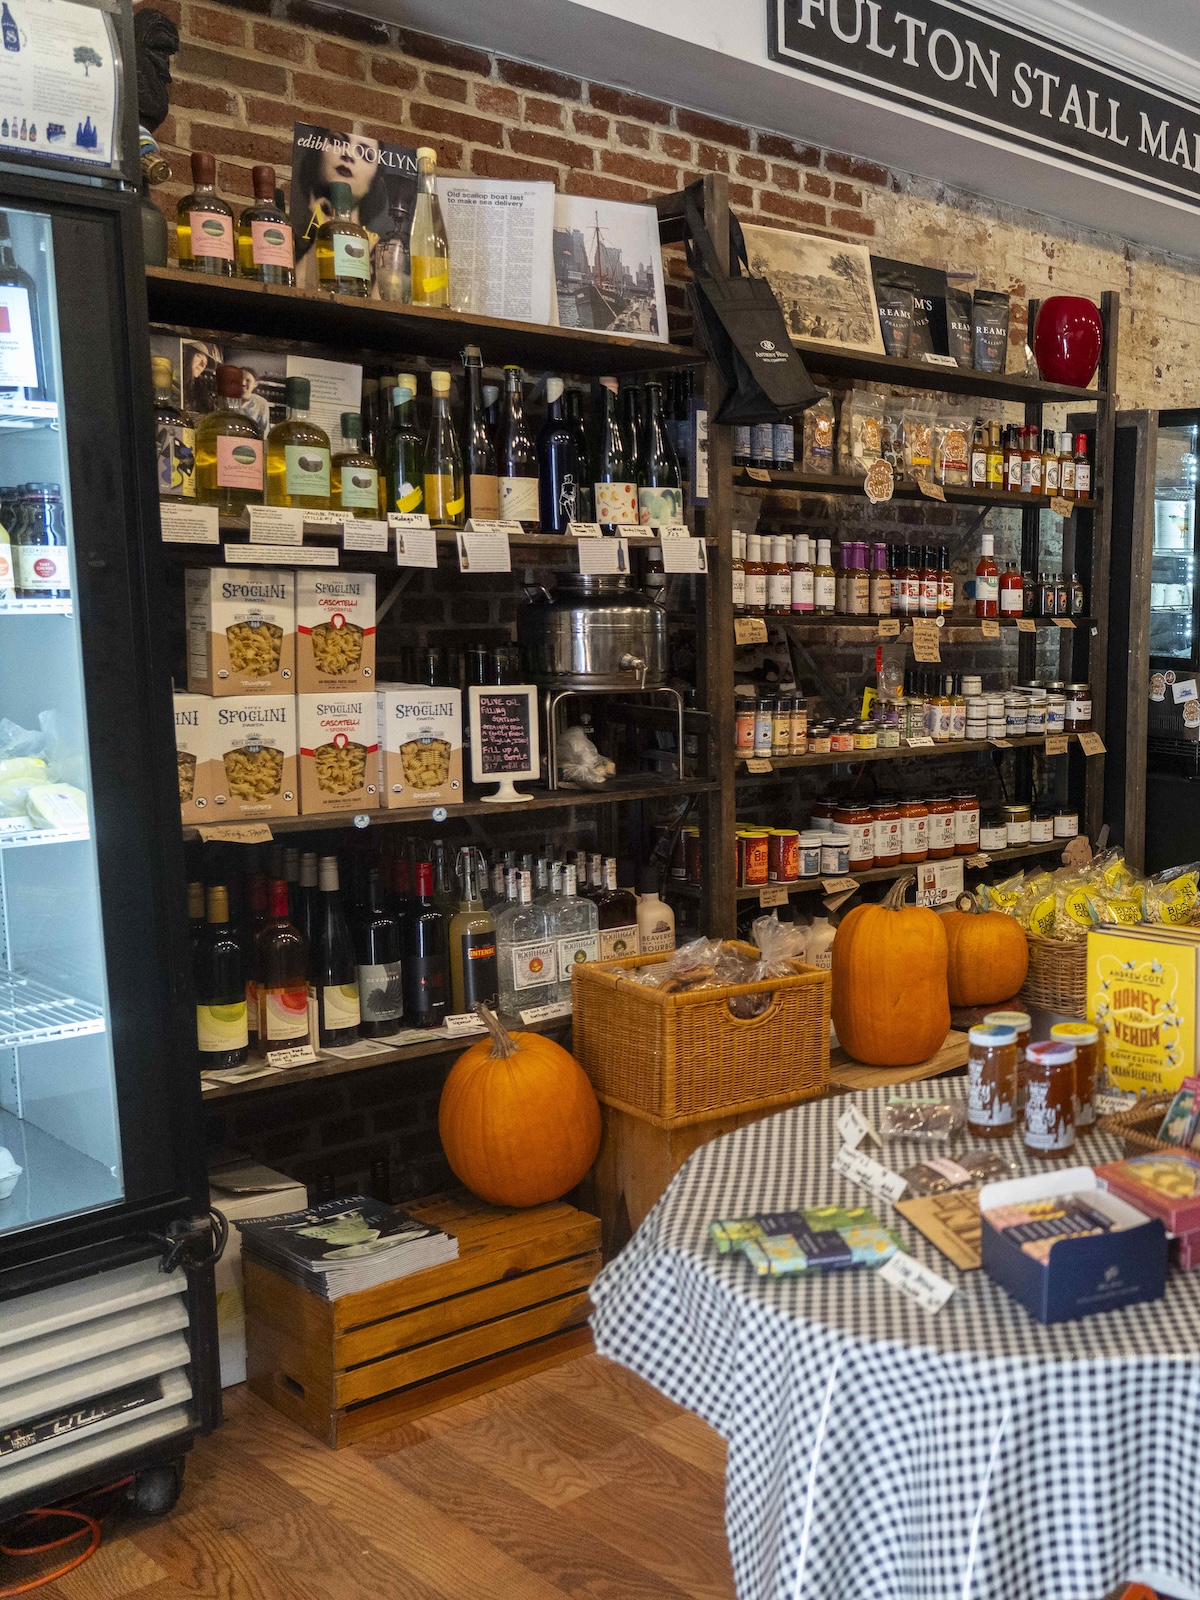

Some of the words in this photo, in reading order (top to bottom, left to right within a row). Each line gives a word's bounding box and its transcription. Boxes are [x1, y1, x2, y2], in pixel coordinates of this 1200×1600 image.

[796, 0, 1000, 97] FULTON
[1012, 61, 1130, 147] STALL
[332, 139, 418, 171] BROOKLYN
[222, 583, 285, 598] SFOGLINI
[315, 583, 360, 594] SFOGLINI
[219, 707, 286, 724] SFOGLINI
[317, 703, 362, 715] SFOGLINI
[396, 703, 453, 719] SFOGLINI
[320, 719, 360, 727] CASCATELLI
[917, 888, 941, 898] MADE
[923, 896, 941, 906] NYC
[642, 934, 674, 942] BEAVERK
[469, 945, 495, 957] INTENSE
[1110, 970, 1141, 980] ANDREW
[1113, 988, 1160, 1016] HONEY
[1129, 1012, 1142, 1022] AND
[1113, 1018, 1159, 1048] VENOM
[1111, 1051, 1163, 1066] CONFESSIONS
[267, 1194, 366, 1223] MANHATTAN
